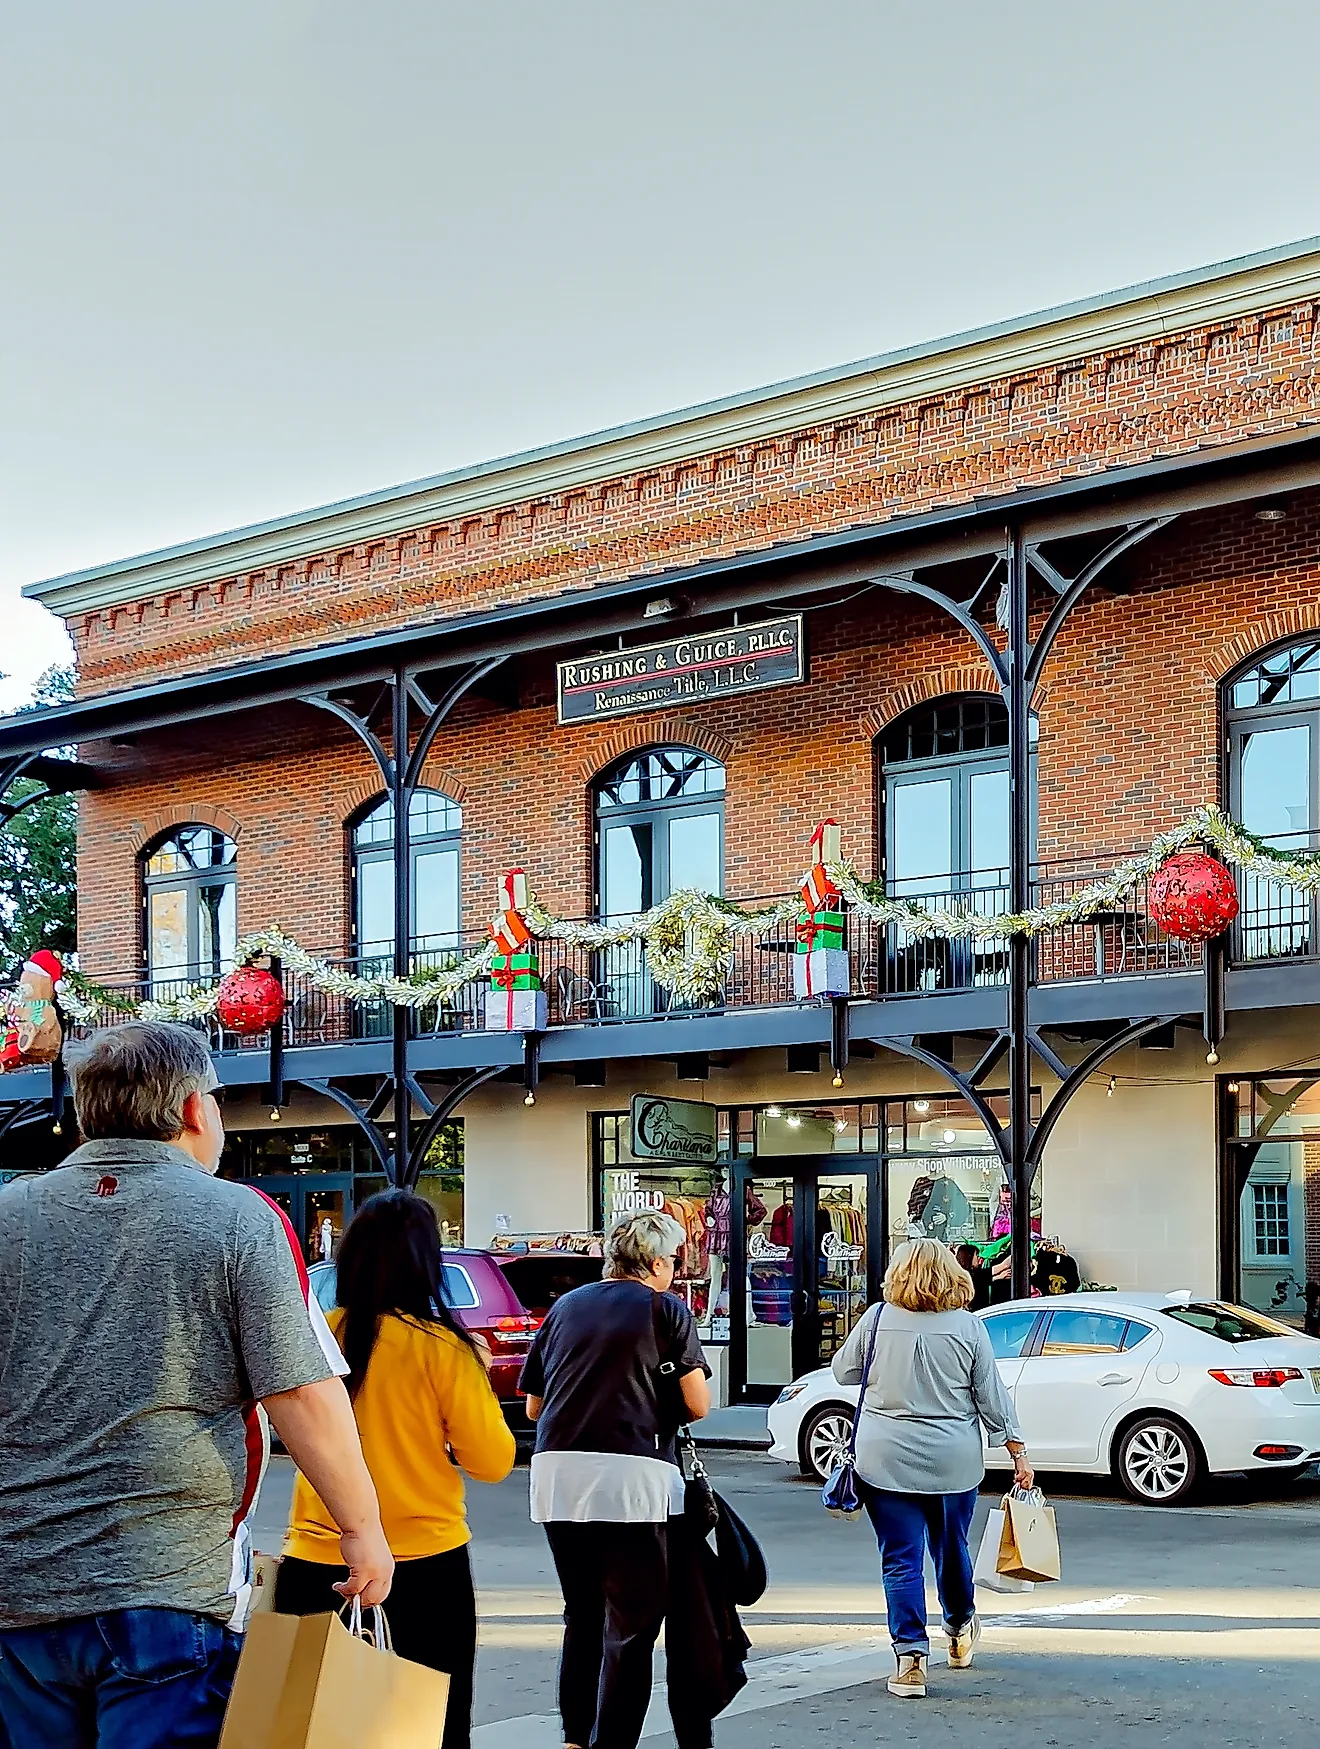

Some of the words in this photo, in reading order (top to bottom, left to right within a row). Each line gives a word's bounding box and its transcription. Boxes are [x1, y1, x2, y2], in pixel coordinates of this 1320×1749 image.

[564, 657, 647, 688] RUSHING
[656, 653, 667, 670] &
[675, 640, 743, 665] GUICE,
[594, 687, 671, 711] Renaissance
[674, 671, 710, 694] Title,
[713, 662, 760, 688] L.L.C.
[611, 1172, 640, 1191] THE
[611, 1190, 664, 1211] WORLD
